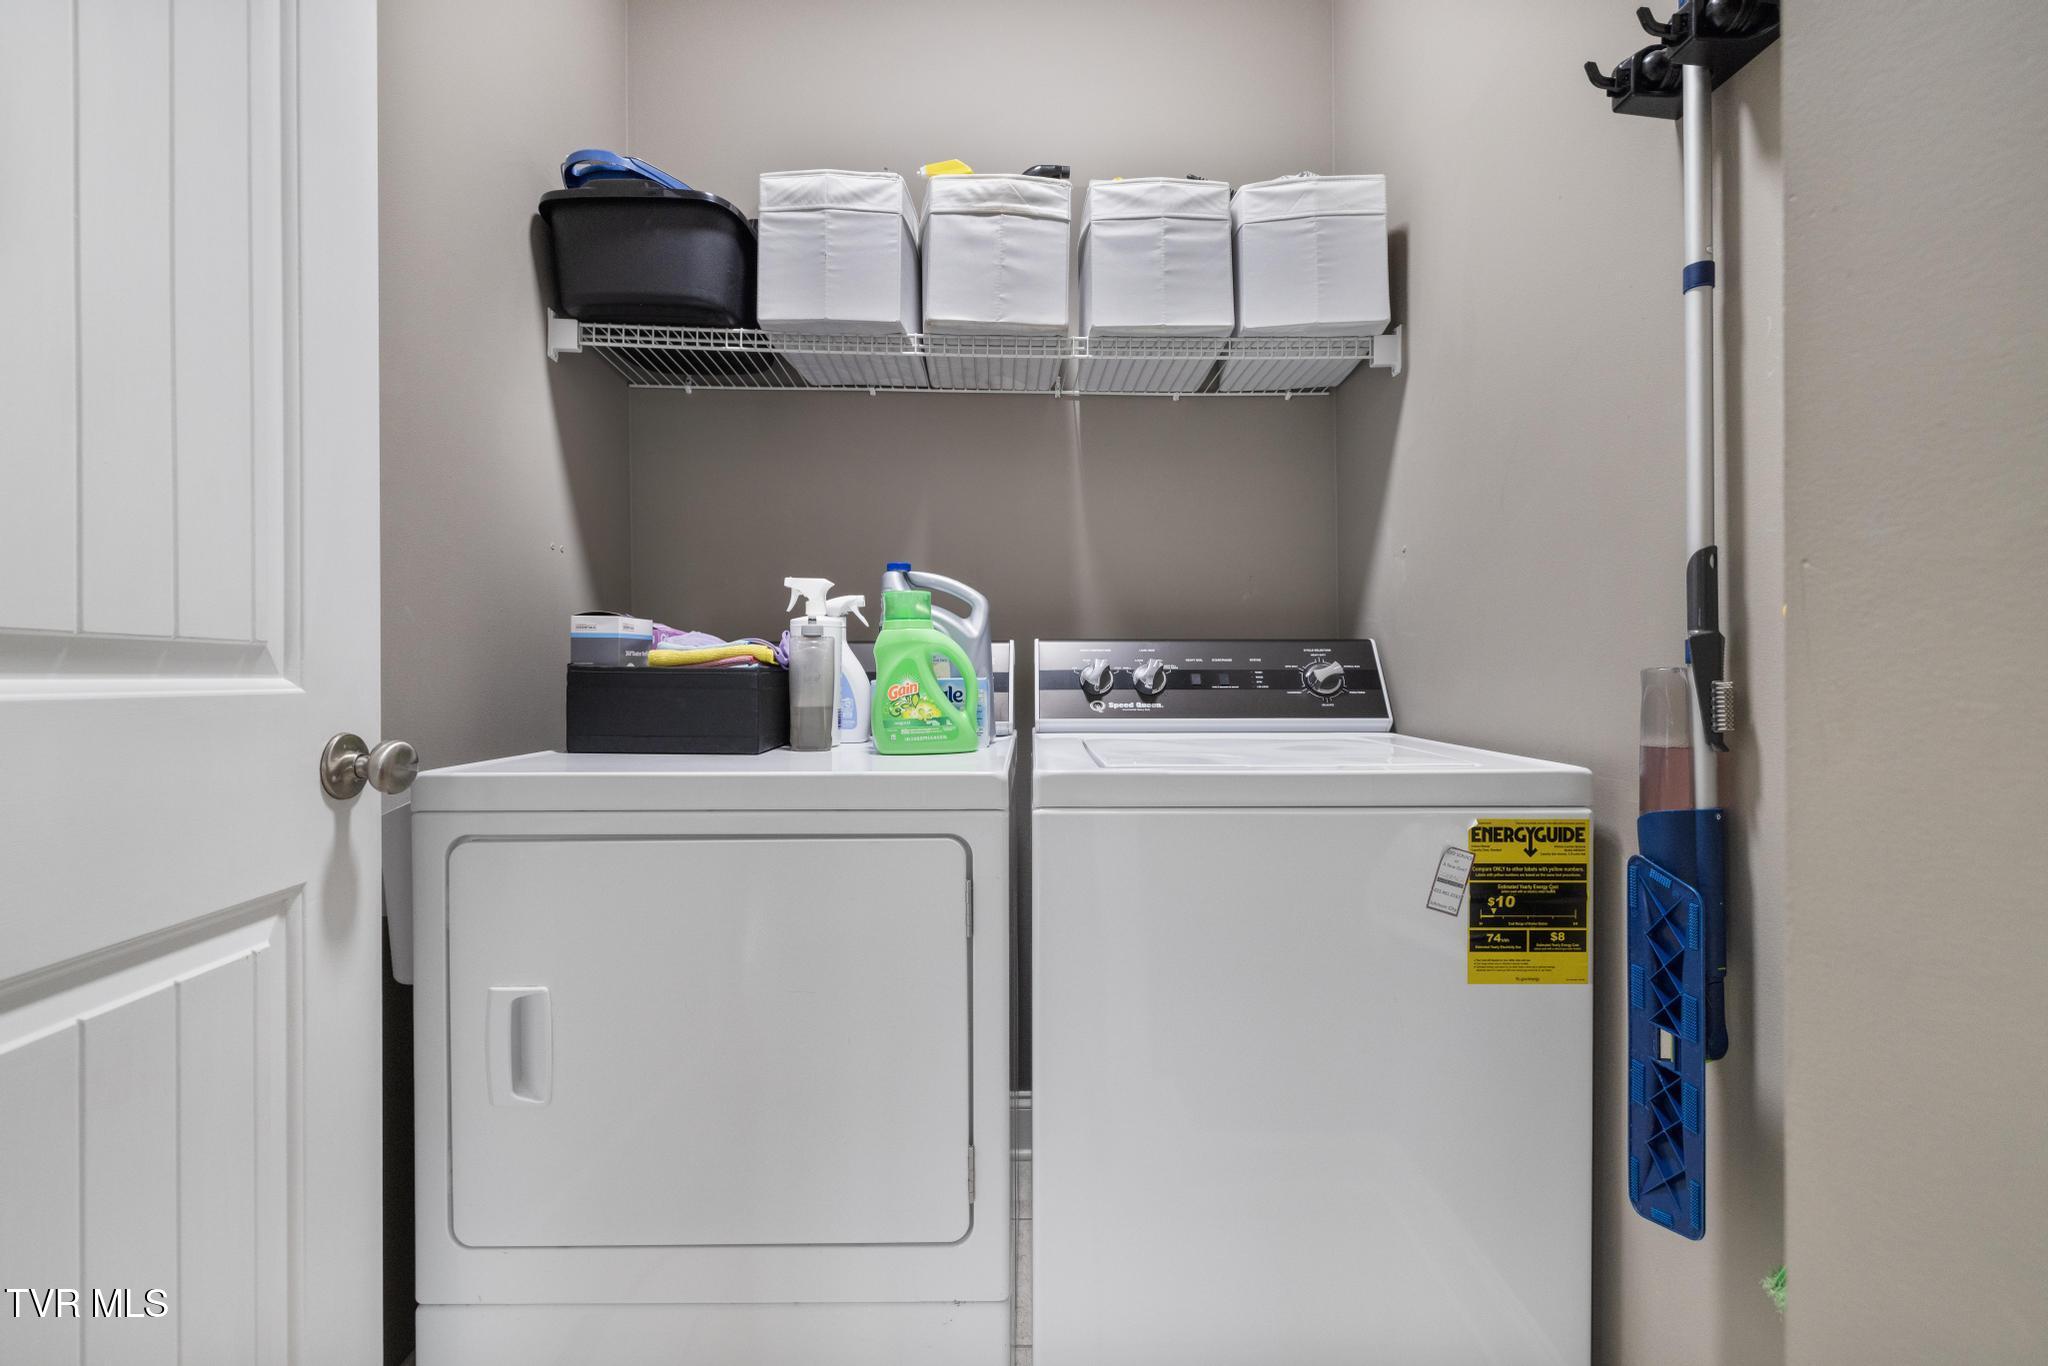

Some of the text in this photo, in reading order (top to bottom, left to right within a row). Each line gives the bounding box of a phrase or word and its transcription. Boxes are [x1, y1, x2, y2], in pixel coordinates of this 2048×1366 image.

[888, 683, 919, 701] Gain
[1471, 826, 1586, 843] ENERGYGUIDE
[1487, 896, 1516, 908] $10
[1486, 933, 1501, 943] 74
[1550, 931, 1565, 942] $8
